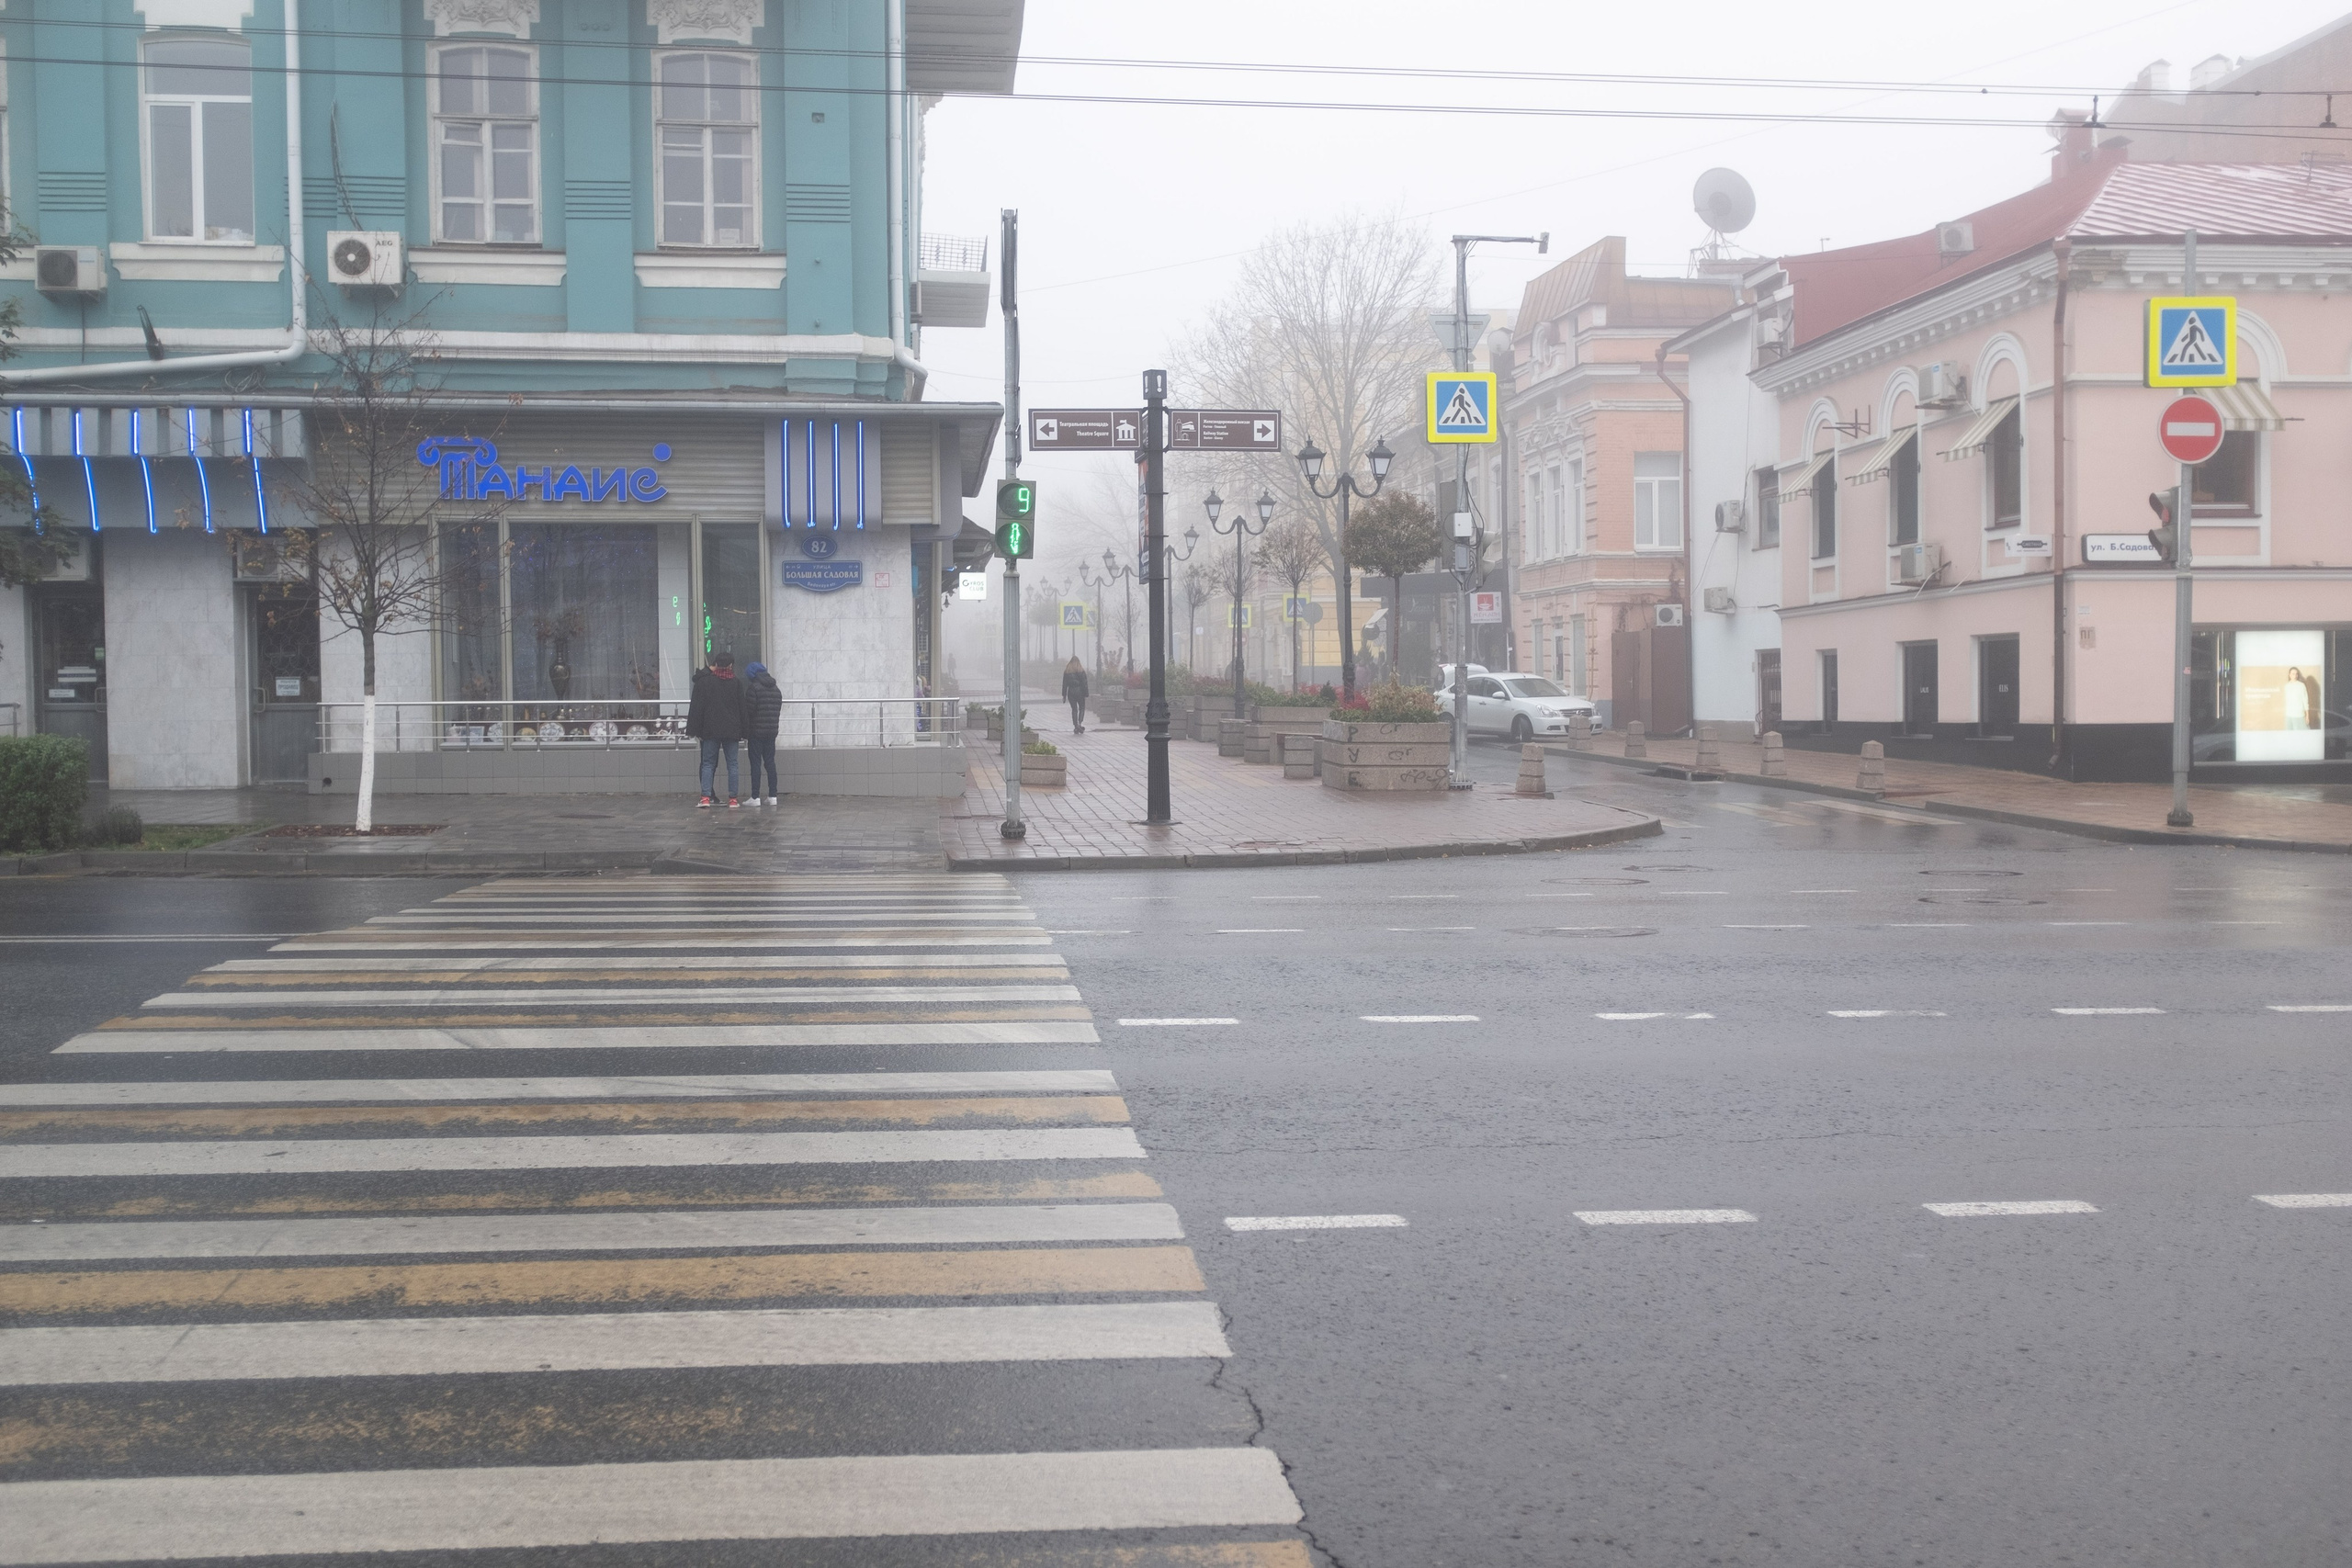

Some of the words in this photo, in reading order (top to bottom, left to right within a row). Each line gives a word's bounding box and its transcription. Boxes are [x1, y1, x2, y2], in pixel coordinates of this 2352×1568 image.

[1018, 487, 1030, 513] 9
[811, 540, 827, 553] 82
[2090, 544, 2106, 552] ул.
[2110, 543, 2156, 552] Б.Садова
